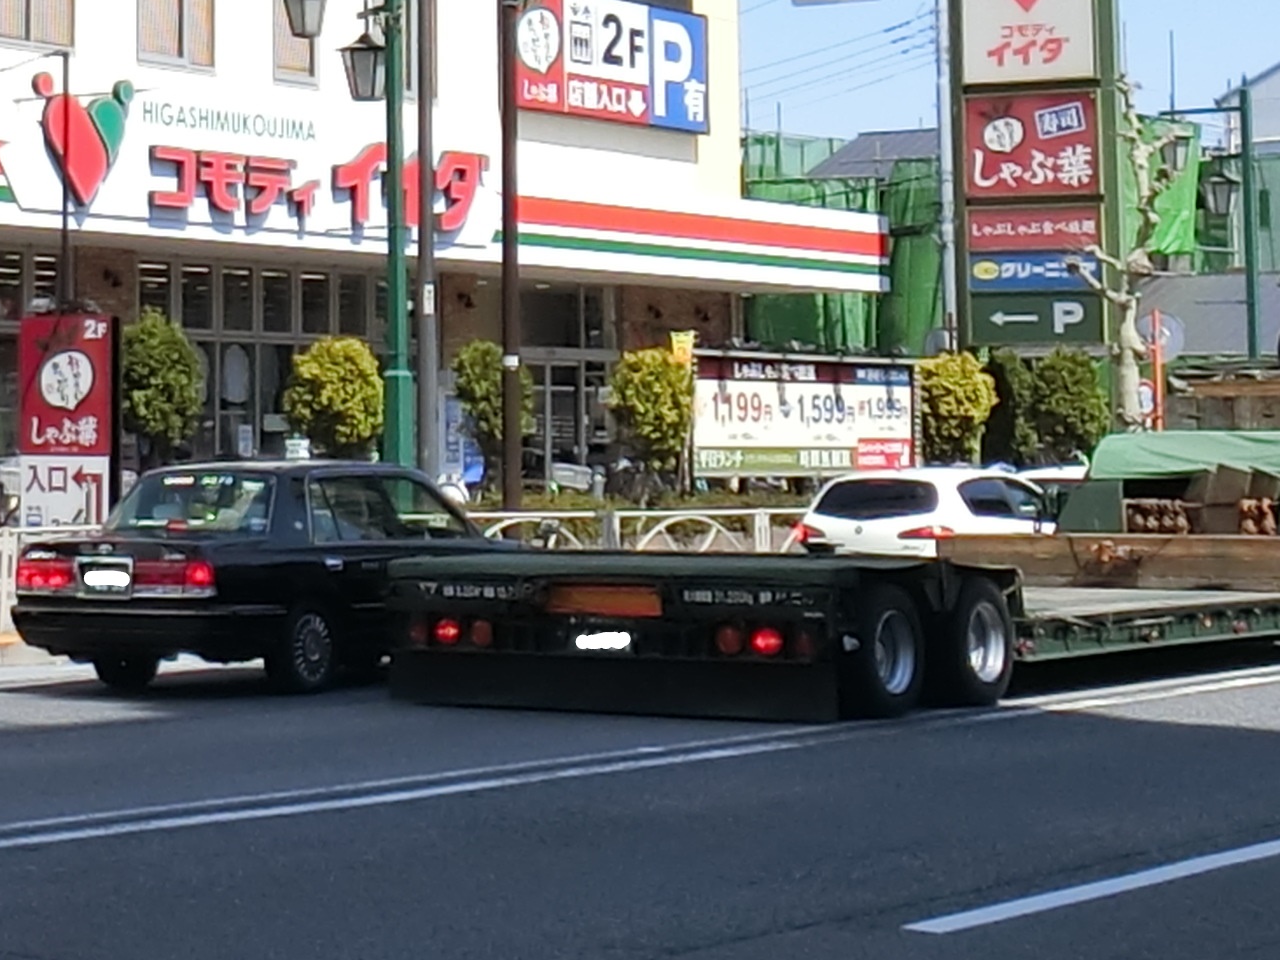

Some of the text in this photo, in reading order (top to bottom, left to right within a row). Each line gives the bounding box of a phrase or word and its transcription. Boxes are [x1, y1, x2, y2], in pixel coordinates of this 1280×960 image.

[602, 13, 644, 69] 2F
[1001, 24, 1055, 39] コモディ
[653, 19, 693, 117] P
[987, 37, 1069, 67] イイダ
[142, 101, 316, 141] HIGASHIMUKOUJIMA
[684, 79, 706, 123] 有
[149, 145, 320, 218] コモディ
[973, 144, 1093, 187] しゃぶ葉
[83, 319, 108, 339] 2F
[1053, 301, 1084, 334] P
[26, 465, 67, 494] 入口
